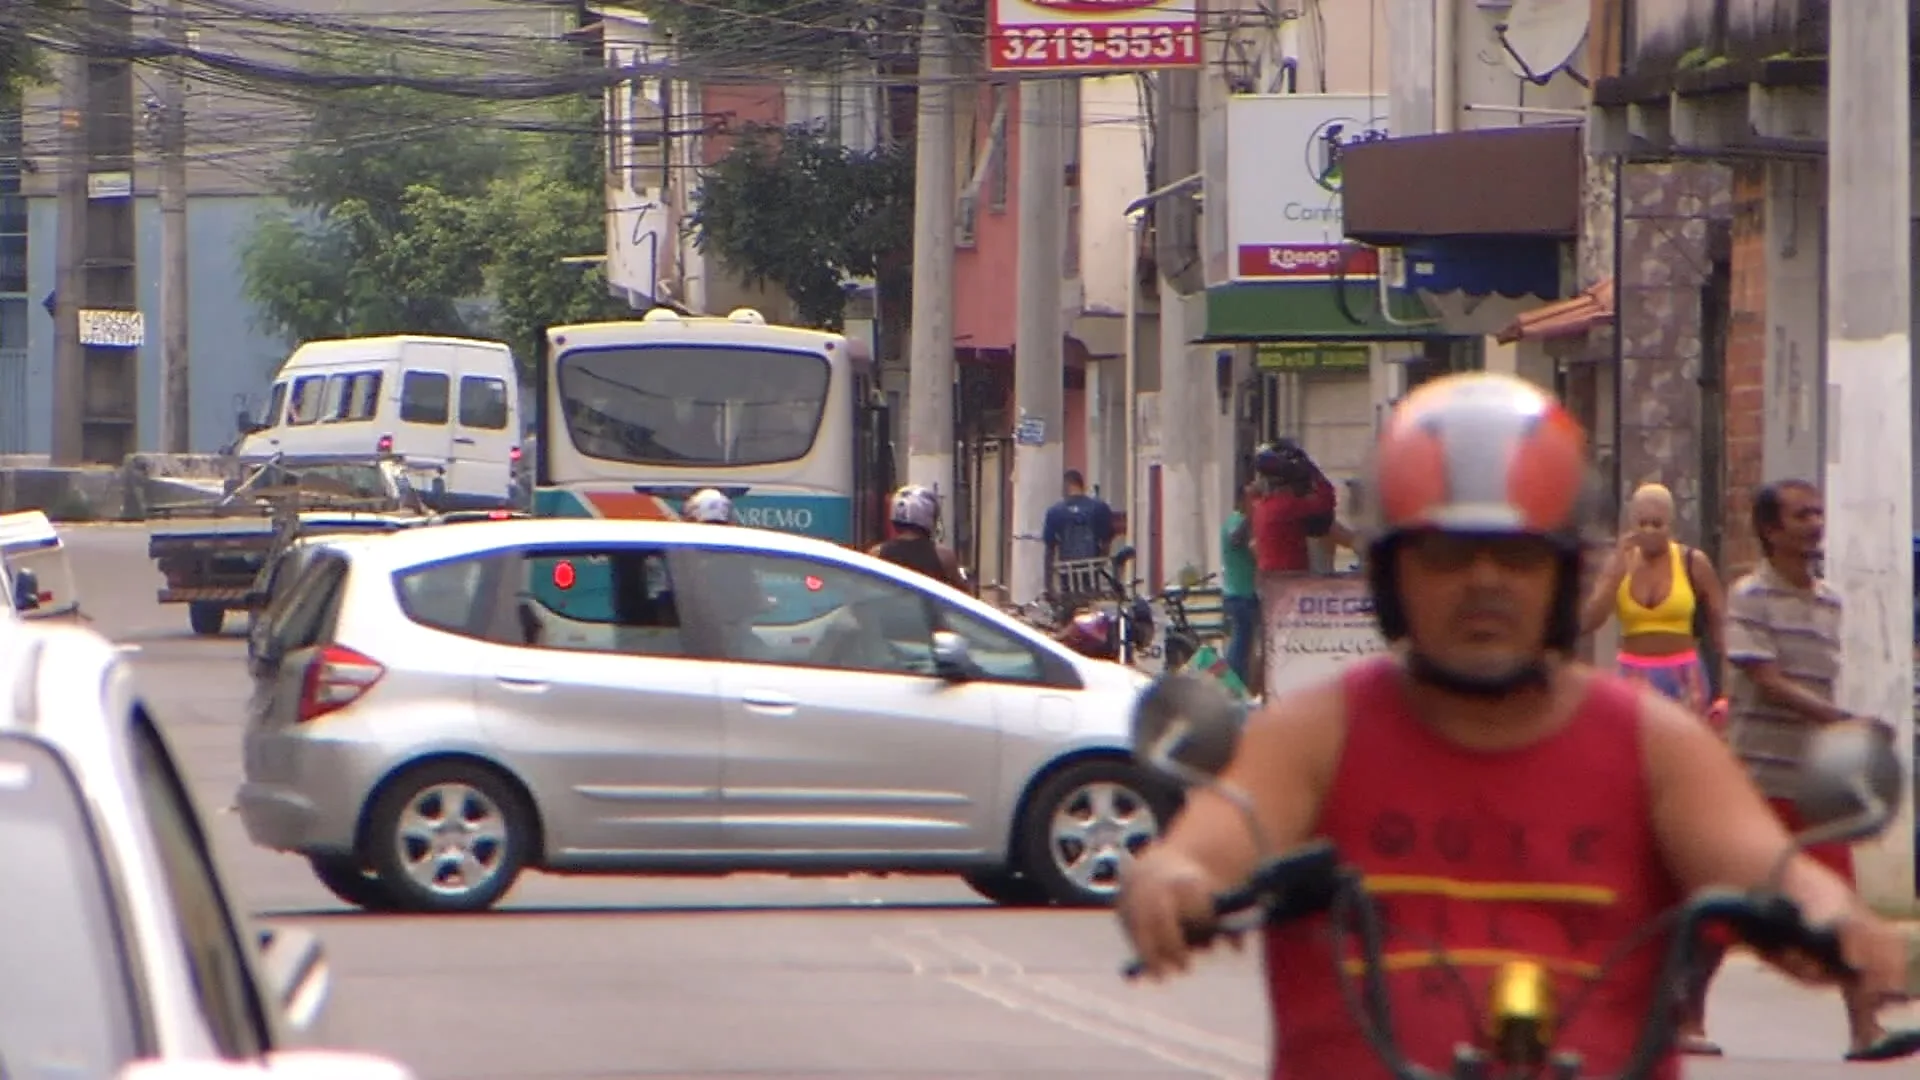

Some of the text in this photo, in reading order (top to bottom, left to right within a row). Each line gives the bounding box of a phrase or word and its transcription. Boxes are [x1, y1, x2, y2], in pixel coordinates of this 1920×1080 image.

[1002, 27, 1194, 60] 3219-5531
[1284, 202, 1343, 224] Camp
[733, 507, 812, 528] NREMO
